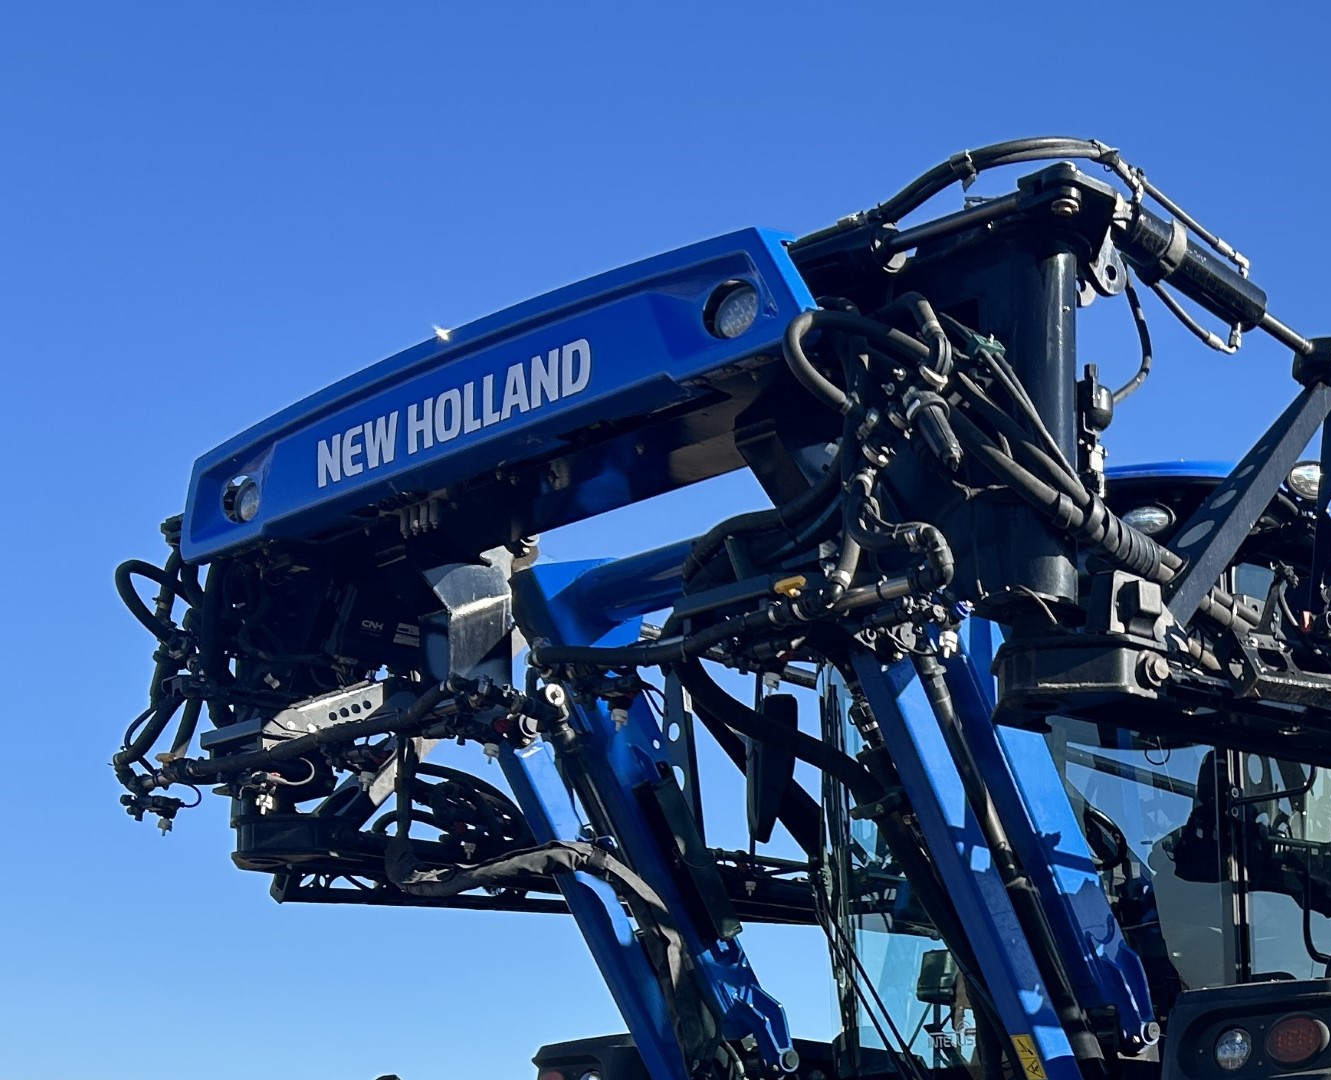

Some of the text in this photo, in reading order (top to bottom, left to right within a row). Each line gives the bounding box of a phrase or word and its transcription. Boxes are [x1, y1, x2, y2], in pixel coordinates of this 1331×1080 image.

[316, 337, 593, 489] NEW HOLLAND
[361, 619, 384, 631] CNH
